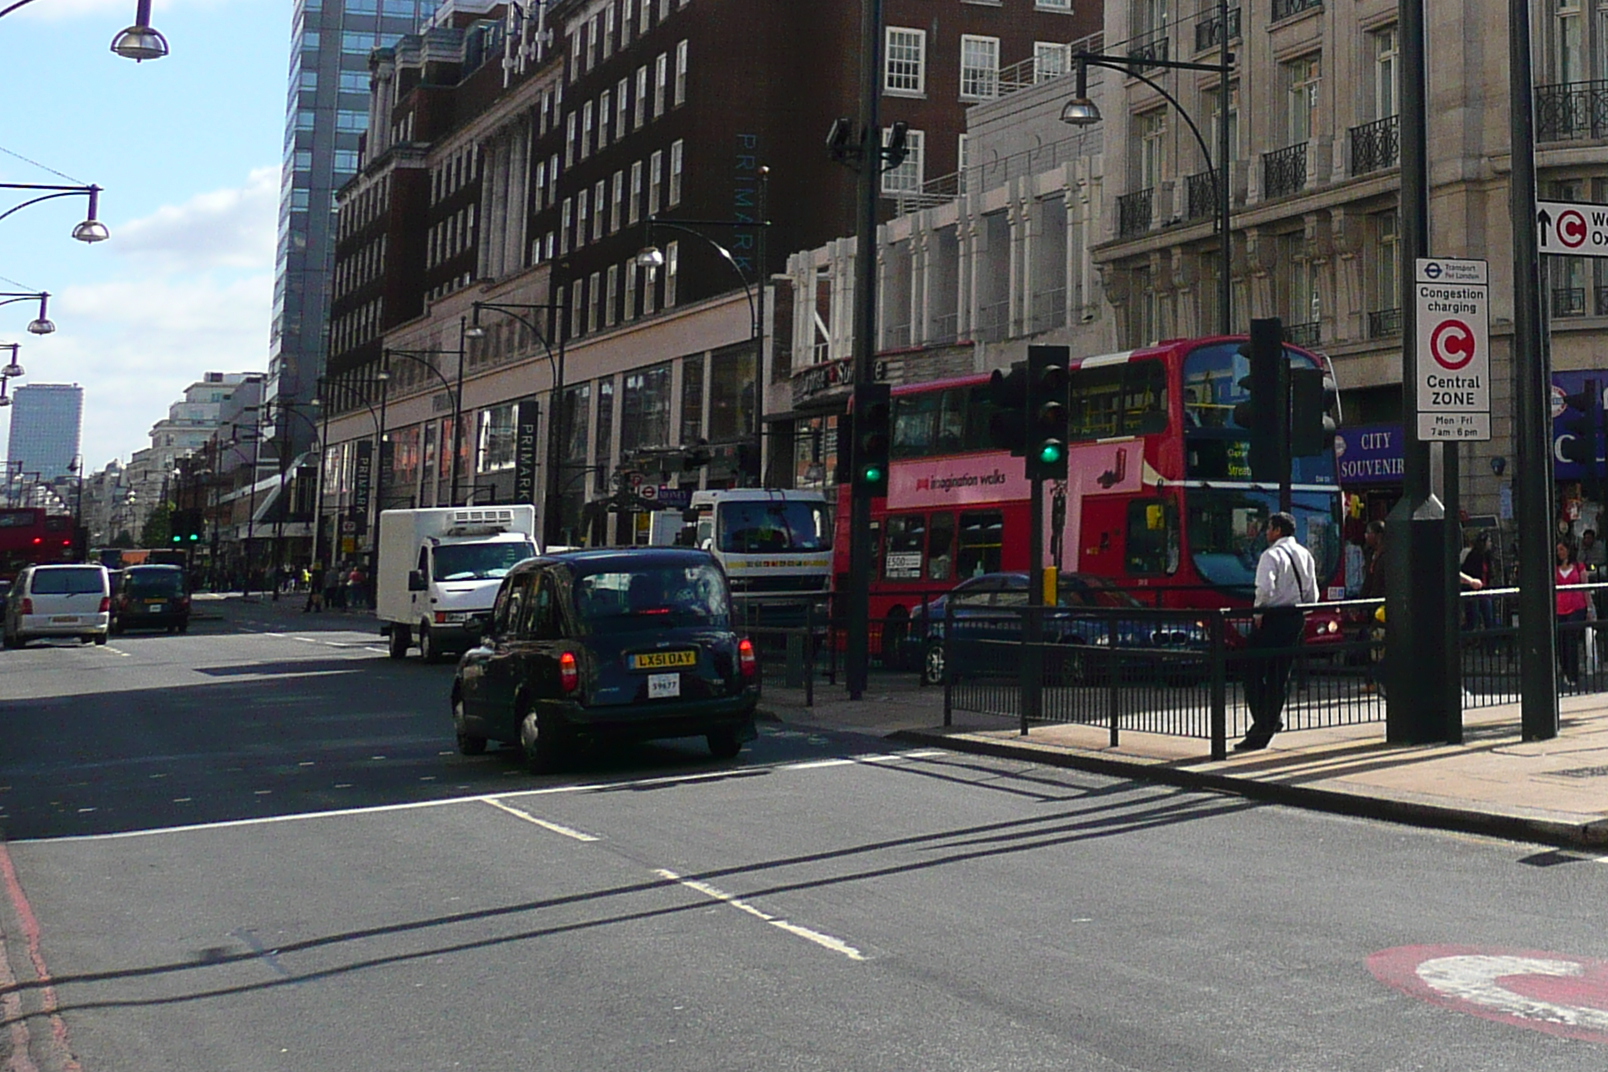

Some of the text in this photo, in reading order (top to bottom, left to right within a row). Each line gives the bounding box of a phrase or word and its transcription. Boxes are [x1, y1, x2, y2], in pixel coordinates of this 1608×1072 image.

[1420, 287, 1484, 300] Congestion
[1428, 302, 1476, 314] charging
[1427, 375, 1480, 388] Central
[1432, 392, 1475, 405] ZONE
[1361, 432, 1392, 449] CITY
[519, 424, 533, 501] PRIMARK
[356, 457, 369, 514] PRIMARK
[931, 469, 1006, 492] imagination walks
